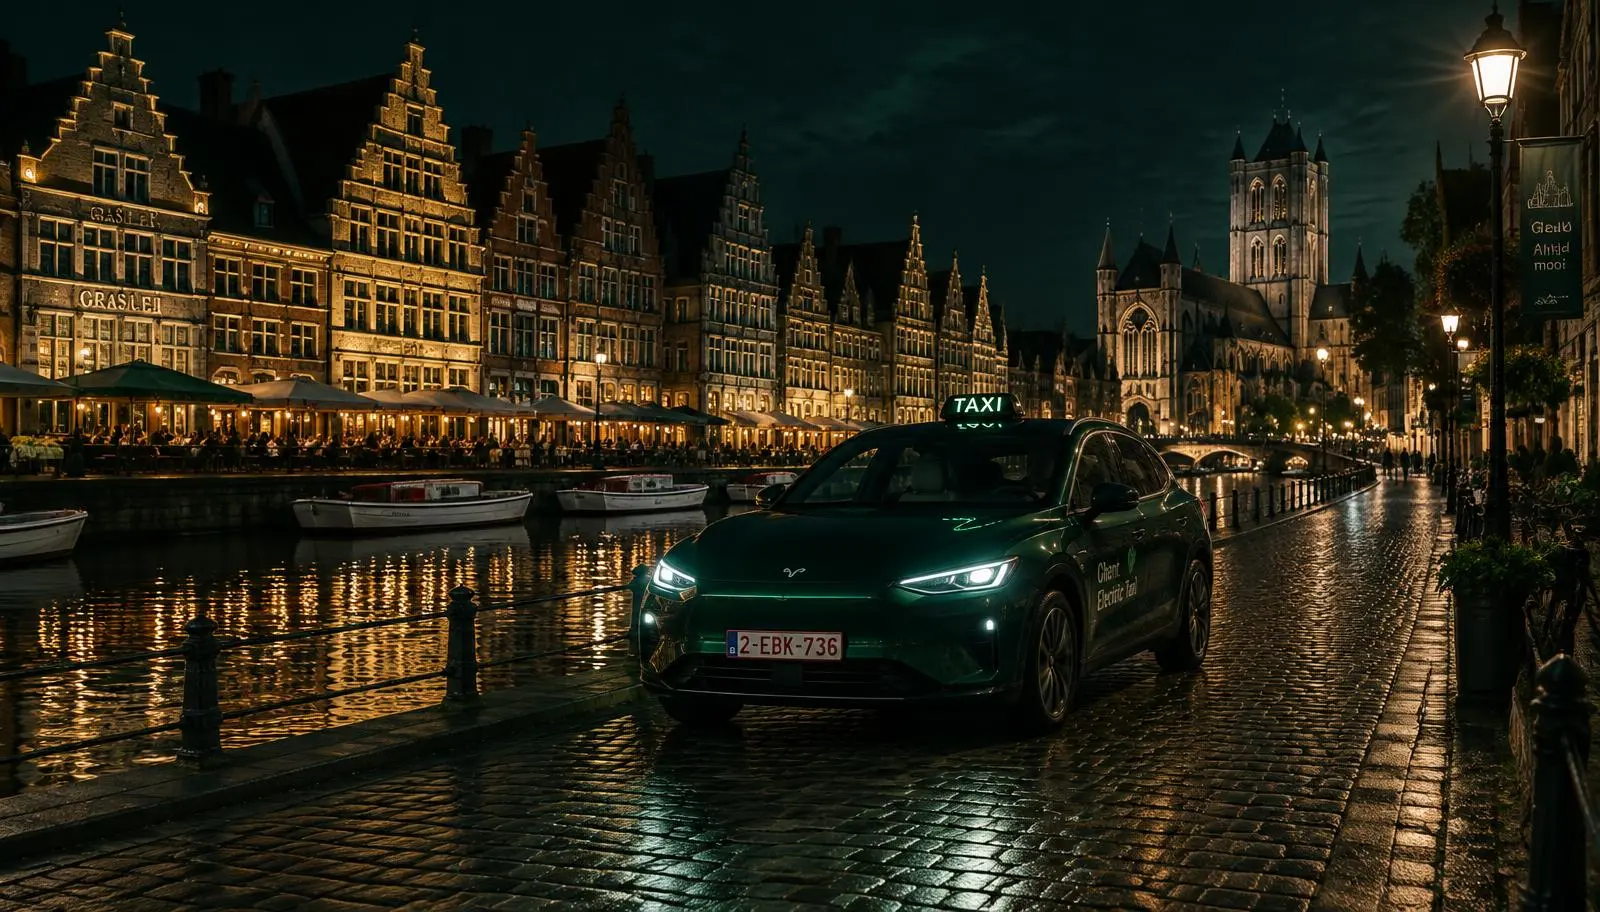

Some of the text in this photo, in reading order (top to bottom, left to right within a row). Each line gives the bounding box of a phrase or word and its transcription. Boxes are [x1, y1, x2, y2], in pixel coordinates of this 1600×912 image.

[1534, 258, 1566, 271] mooi
[953, 396, 1003, 413] TAXI
[739, 635, 838, 656] 2-EBK-736
